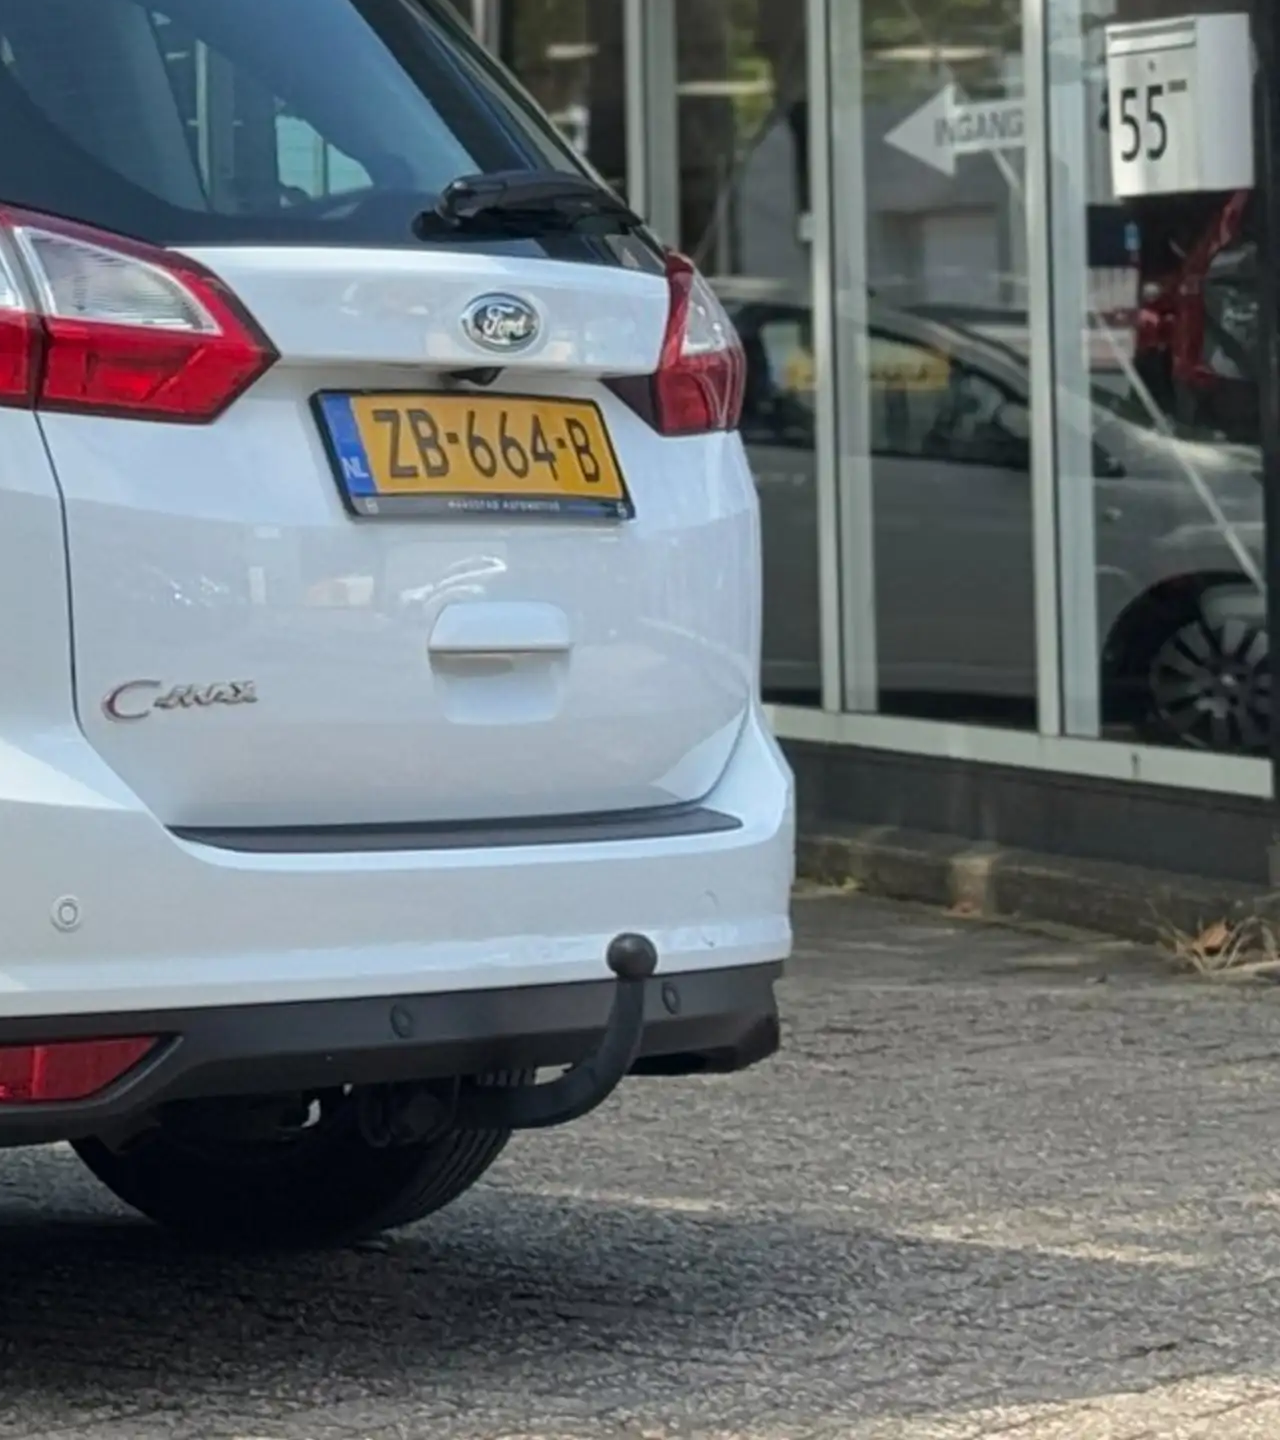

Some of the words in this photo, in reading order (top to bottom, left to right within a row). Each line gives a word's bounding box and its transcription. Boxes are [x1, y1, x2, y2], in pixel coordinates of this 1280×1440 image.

[1120, 85, 1167, 162] 55
[342, 456, 369, 479] NL
[372, 409, 601, 483] ZB-664-B
